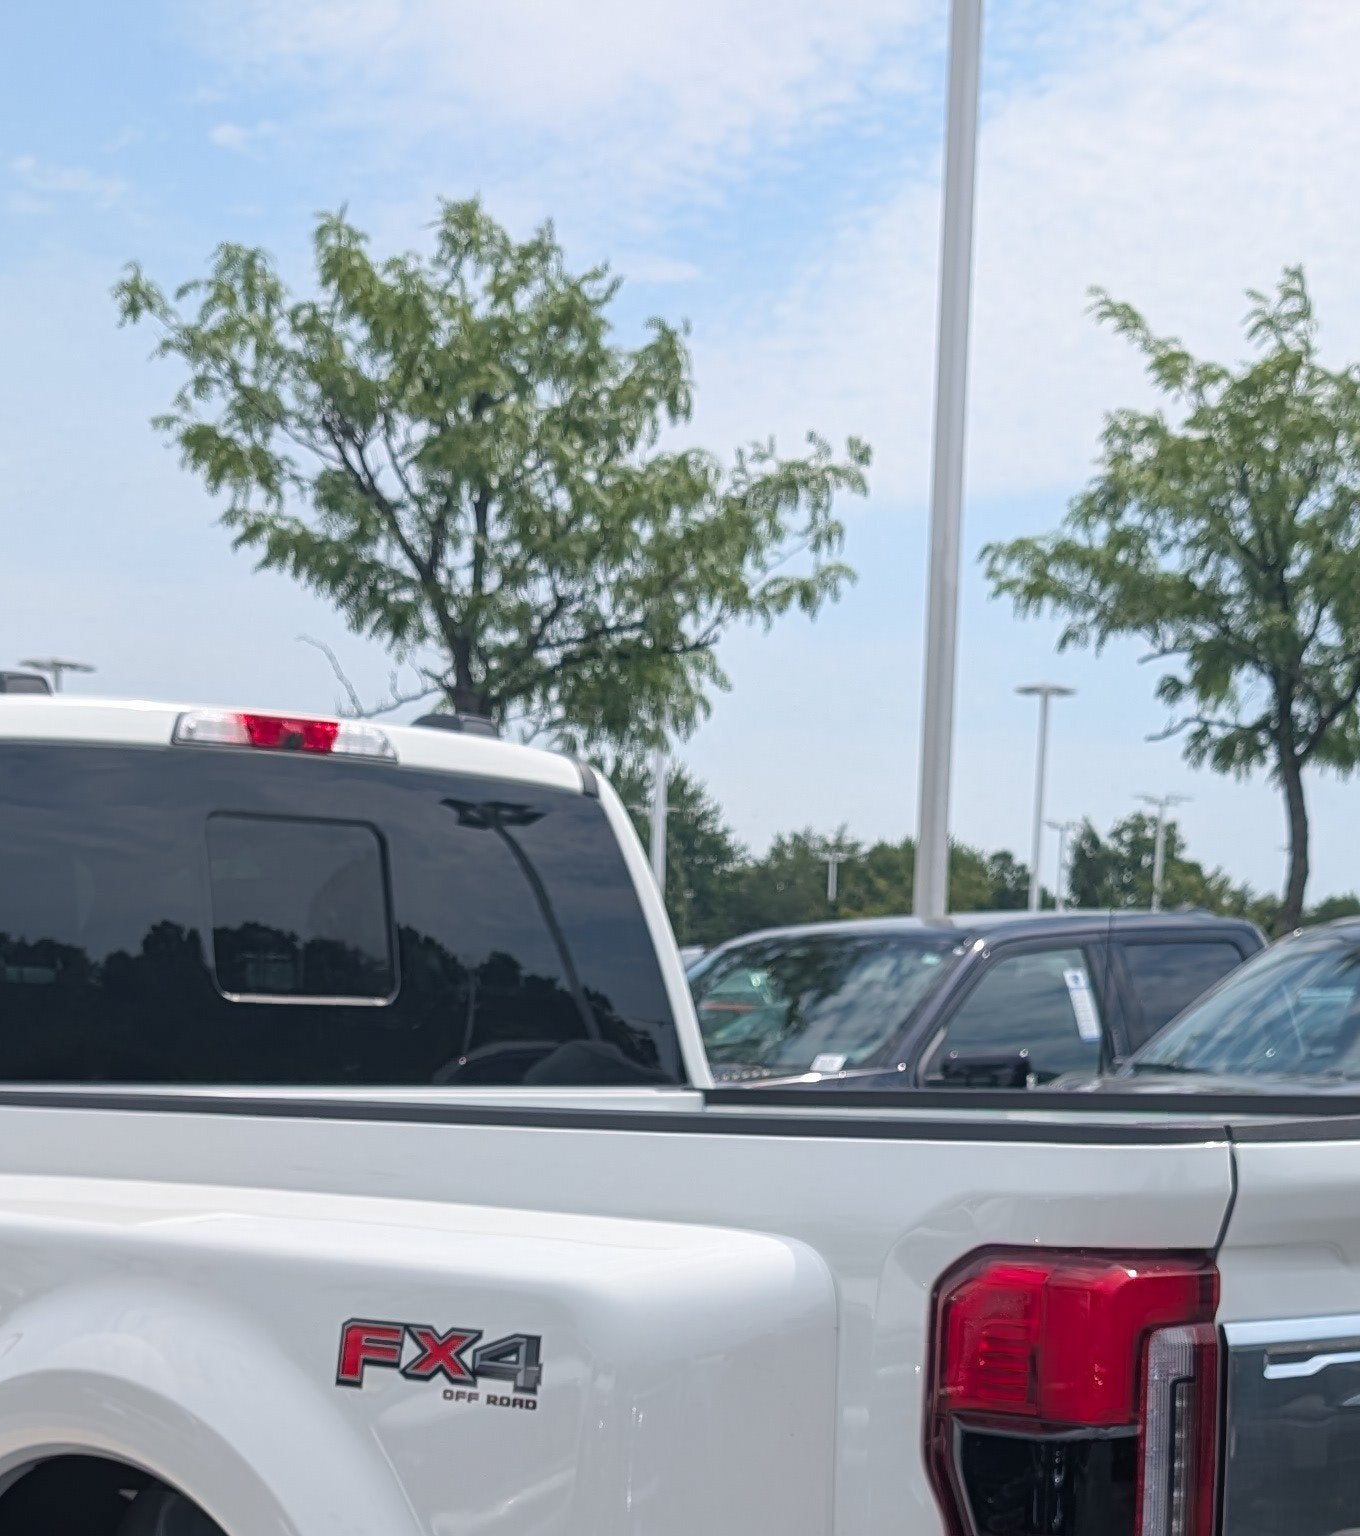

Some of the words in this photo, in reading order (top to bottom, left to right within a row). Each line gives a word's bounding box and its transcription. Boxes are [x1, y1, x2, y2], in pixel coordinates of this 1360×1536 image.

[335, 1317, 542, 1395] FX4
[442, 1389, 480, 1404] OFF
[486, 1394, 538, 1411] ROAD
